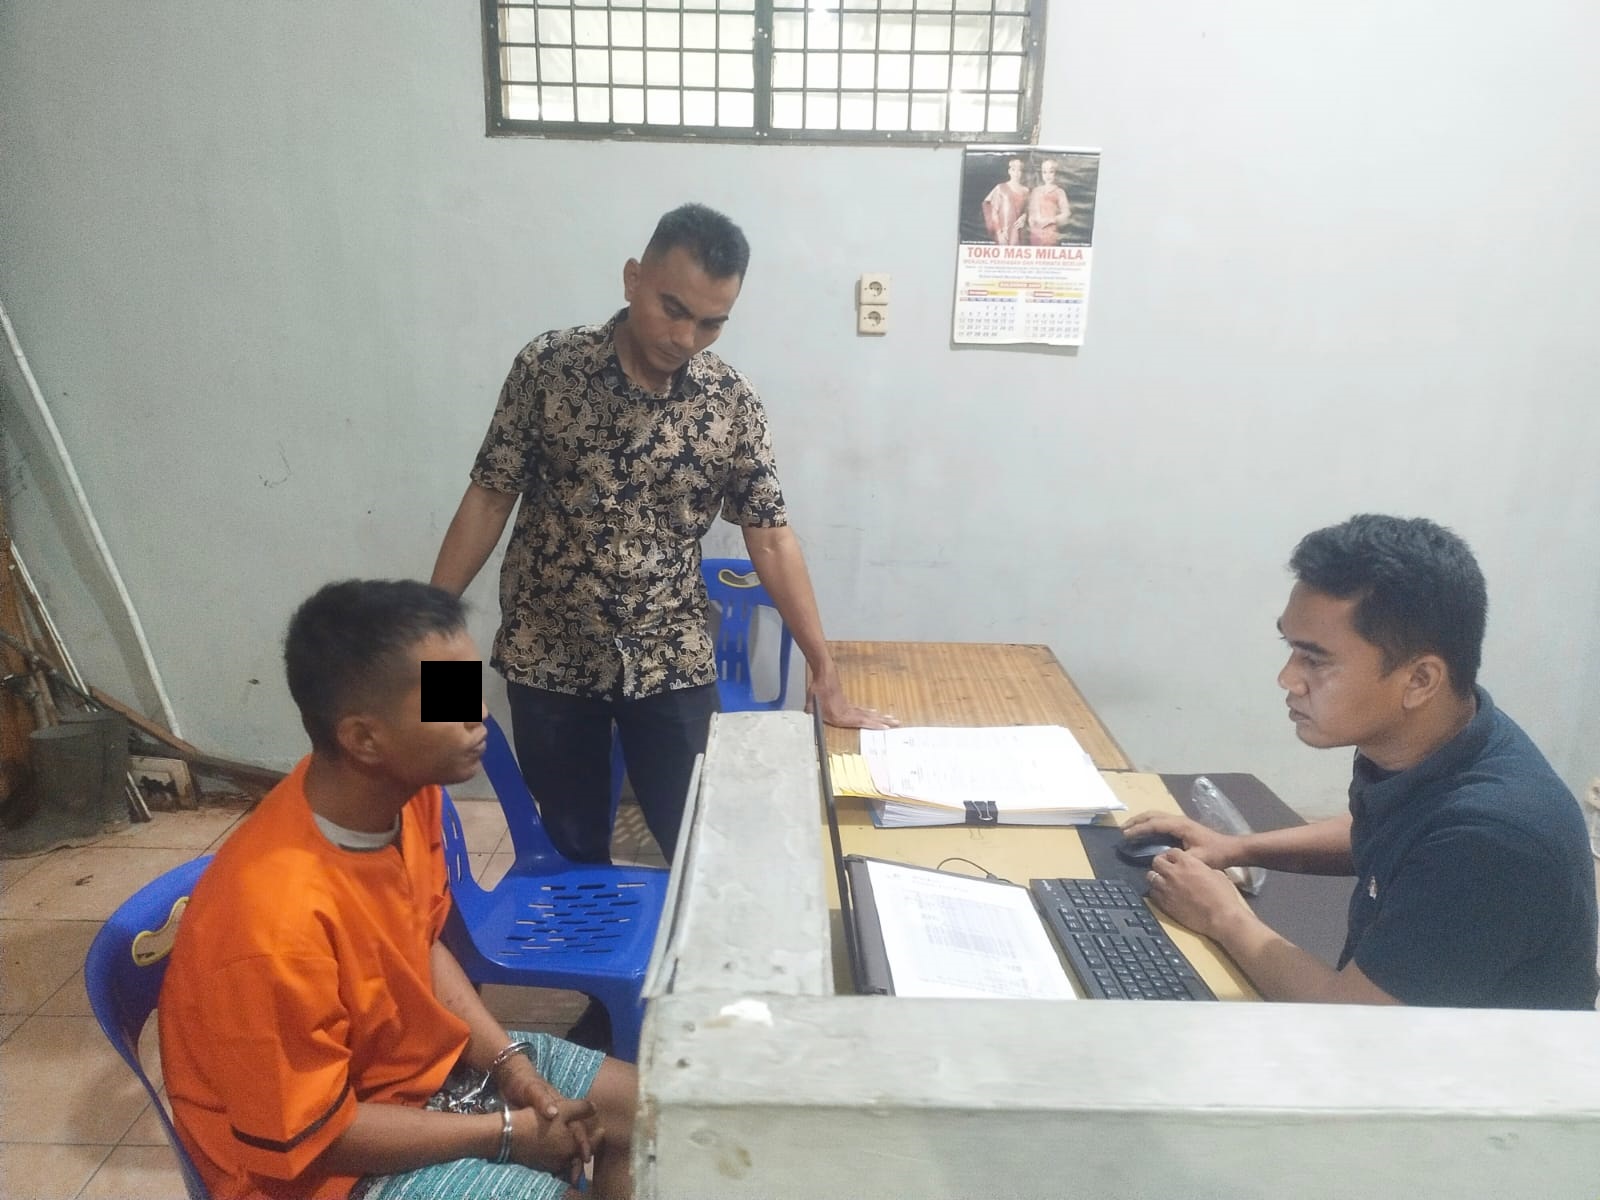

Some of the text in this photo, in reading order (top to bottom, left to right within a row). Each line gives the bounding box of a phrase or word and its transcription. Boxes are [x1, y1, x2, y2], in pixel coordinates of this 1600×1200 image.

[967, 247, 1084, 260] TOKO MAS MILALA
